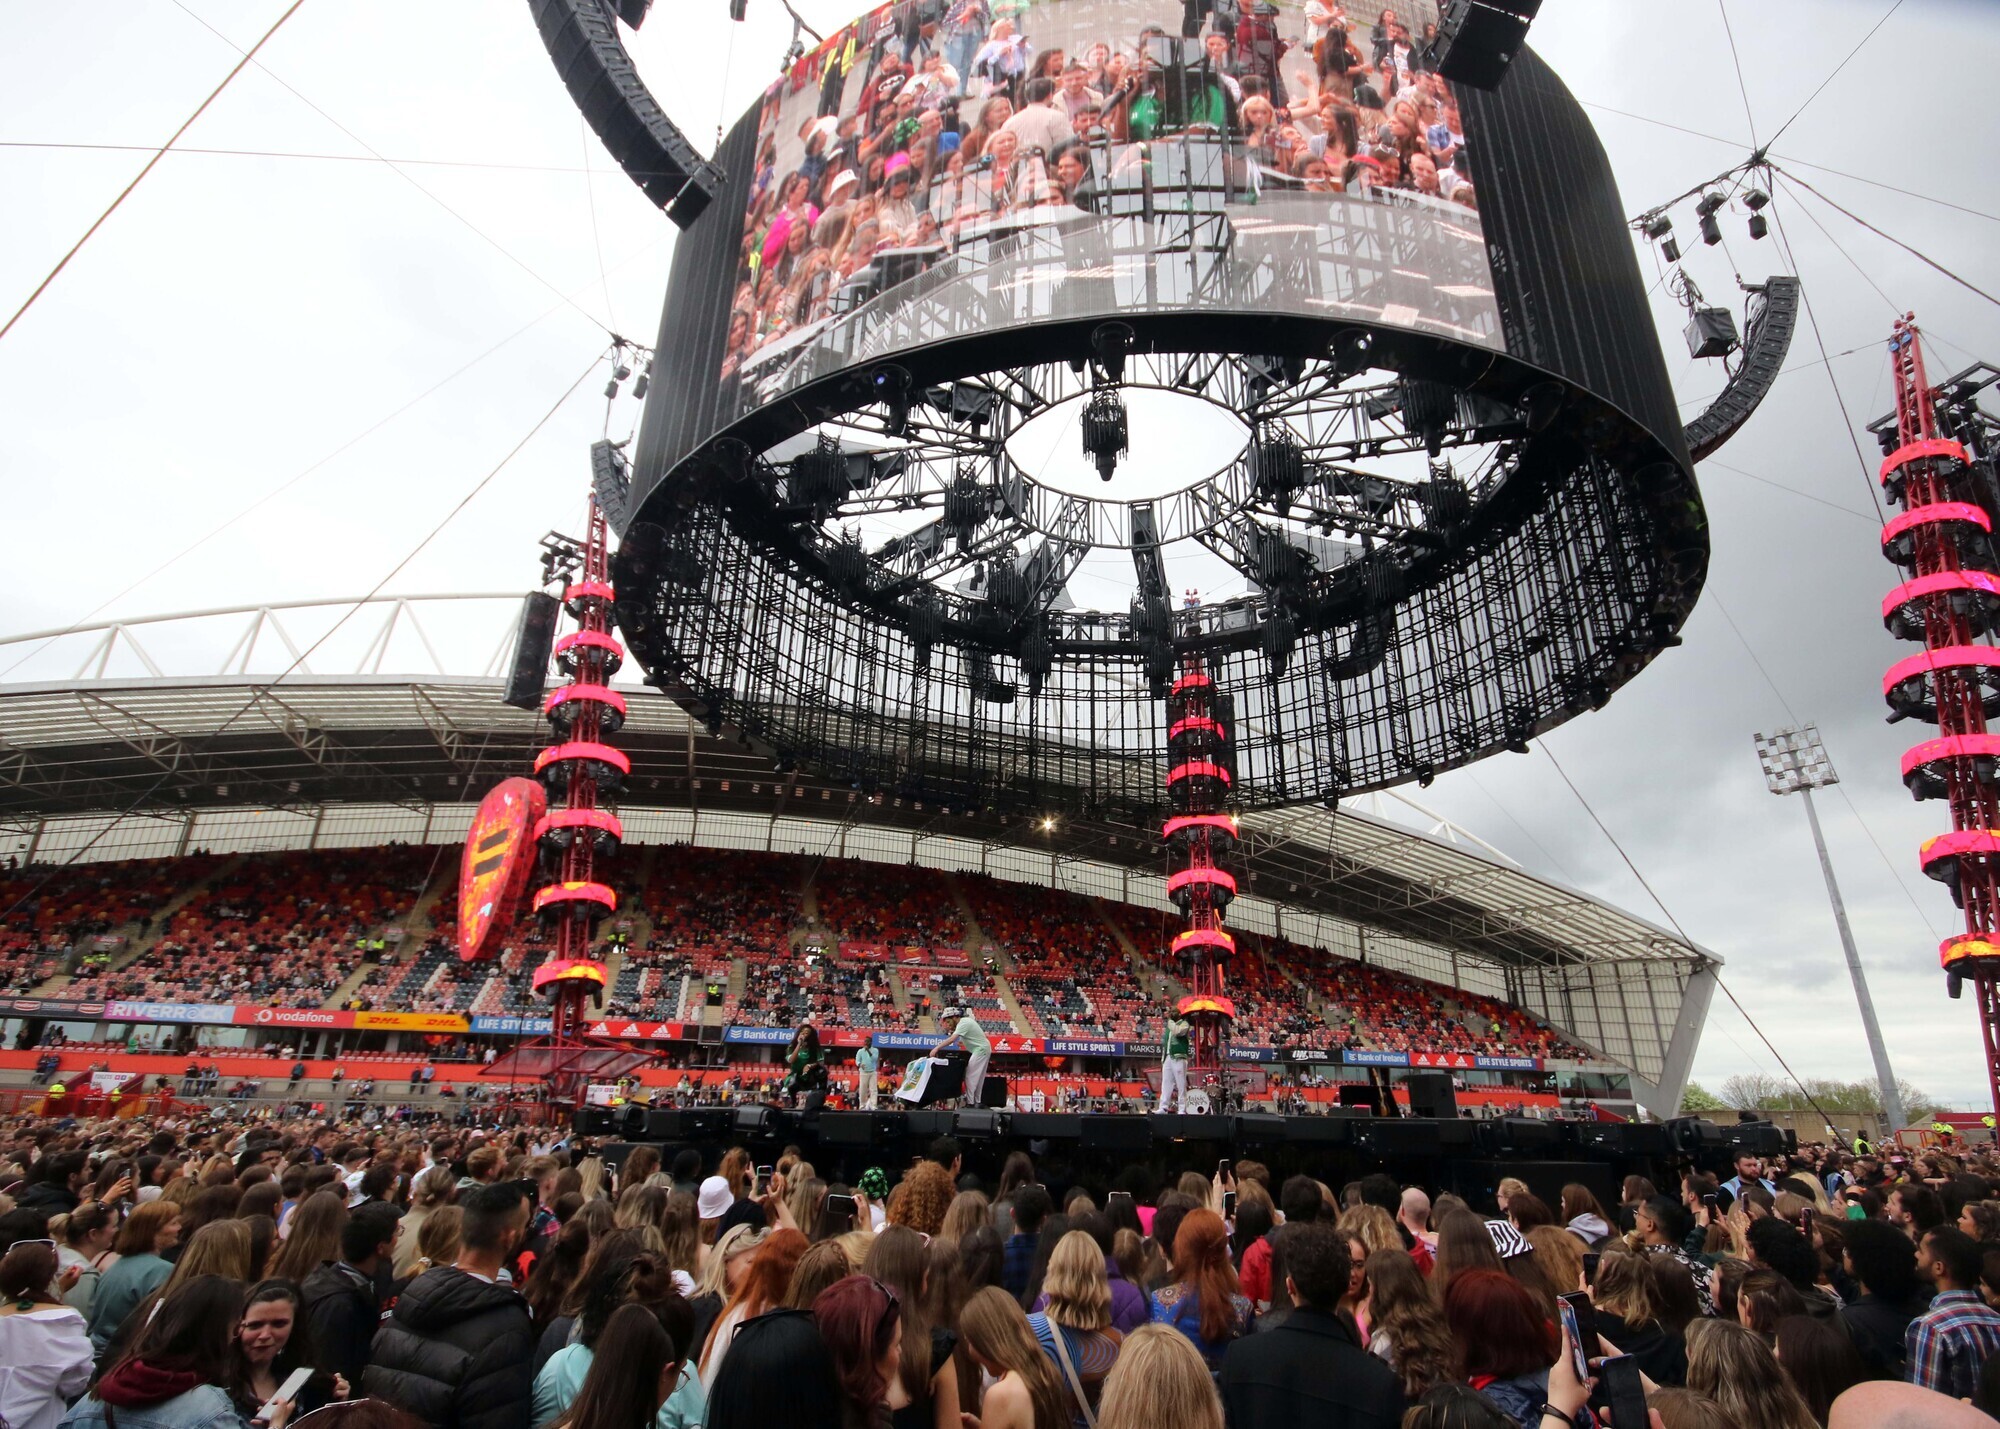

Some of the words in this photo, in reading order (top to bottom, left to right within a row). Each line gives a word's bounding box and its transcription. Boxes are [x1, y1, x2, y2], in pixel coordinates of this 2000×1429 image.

[112, 1003, 226, 1020] RIVERROCK
[275, 1011, 334, 1023] vodafone
[367, 1016, 401, 1025] DHL
[425, 1018, 457, 1027] DHL
[477, 1018, 499, 1030] LIFE
[501, 1019, 532, 1031] STYLE
[534, 1021, 553, 1032] SPO
[743, 1030, 767, 1040] Bank
[767, 1030, 777, 1040] of
[779, 1031, 794, 1041] Irel
[890, 1035, 912, 1045] Bank
[912, 1036, 923, 1046] of
[1052, 1042, 1067, 1051] LIFE
[1067, 1043, 1089, 1052] STYLE
[1129, 1044, 1155, 1053] MARKS
[1229, 1048, 1260, 1059] Pinergy
[1357, 1053, 1373, 1061] Bank
[1382, 1054, 1406, 1063] Ireland
[1478, 1057, 1490, 1066] LIFE
[1491, 1058, 1509, 1067] STYLE
[1510, 1058, 1532, 1068] SPORTS
